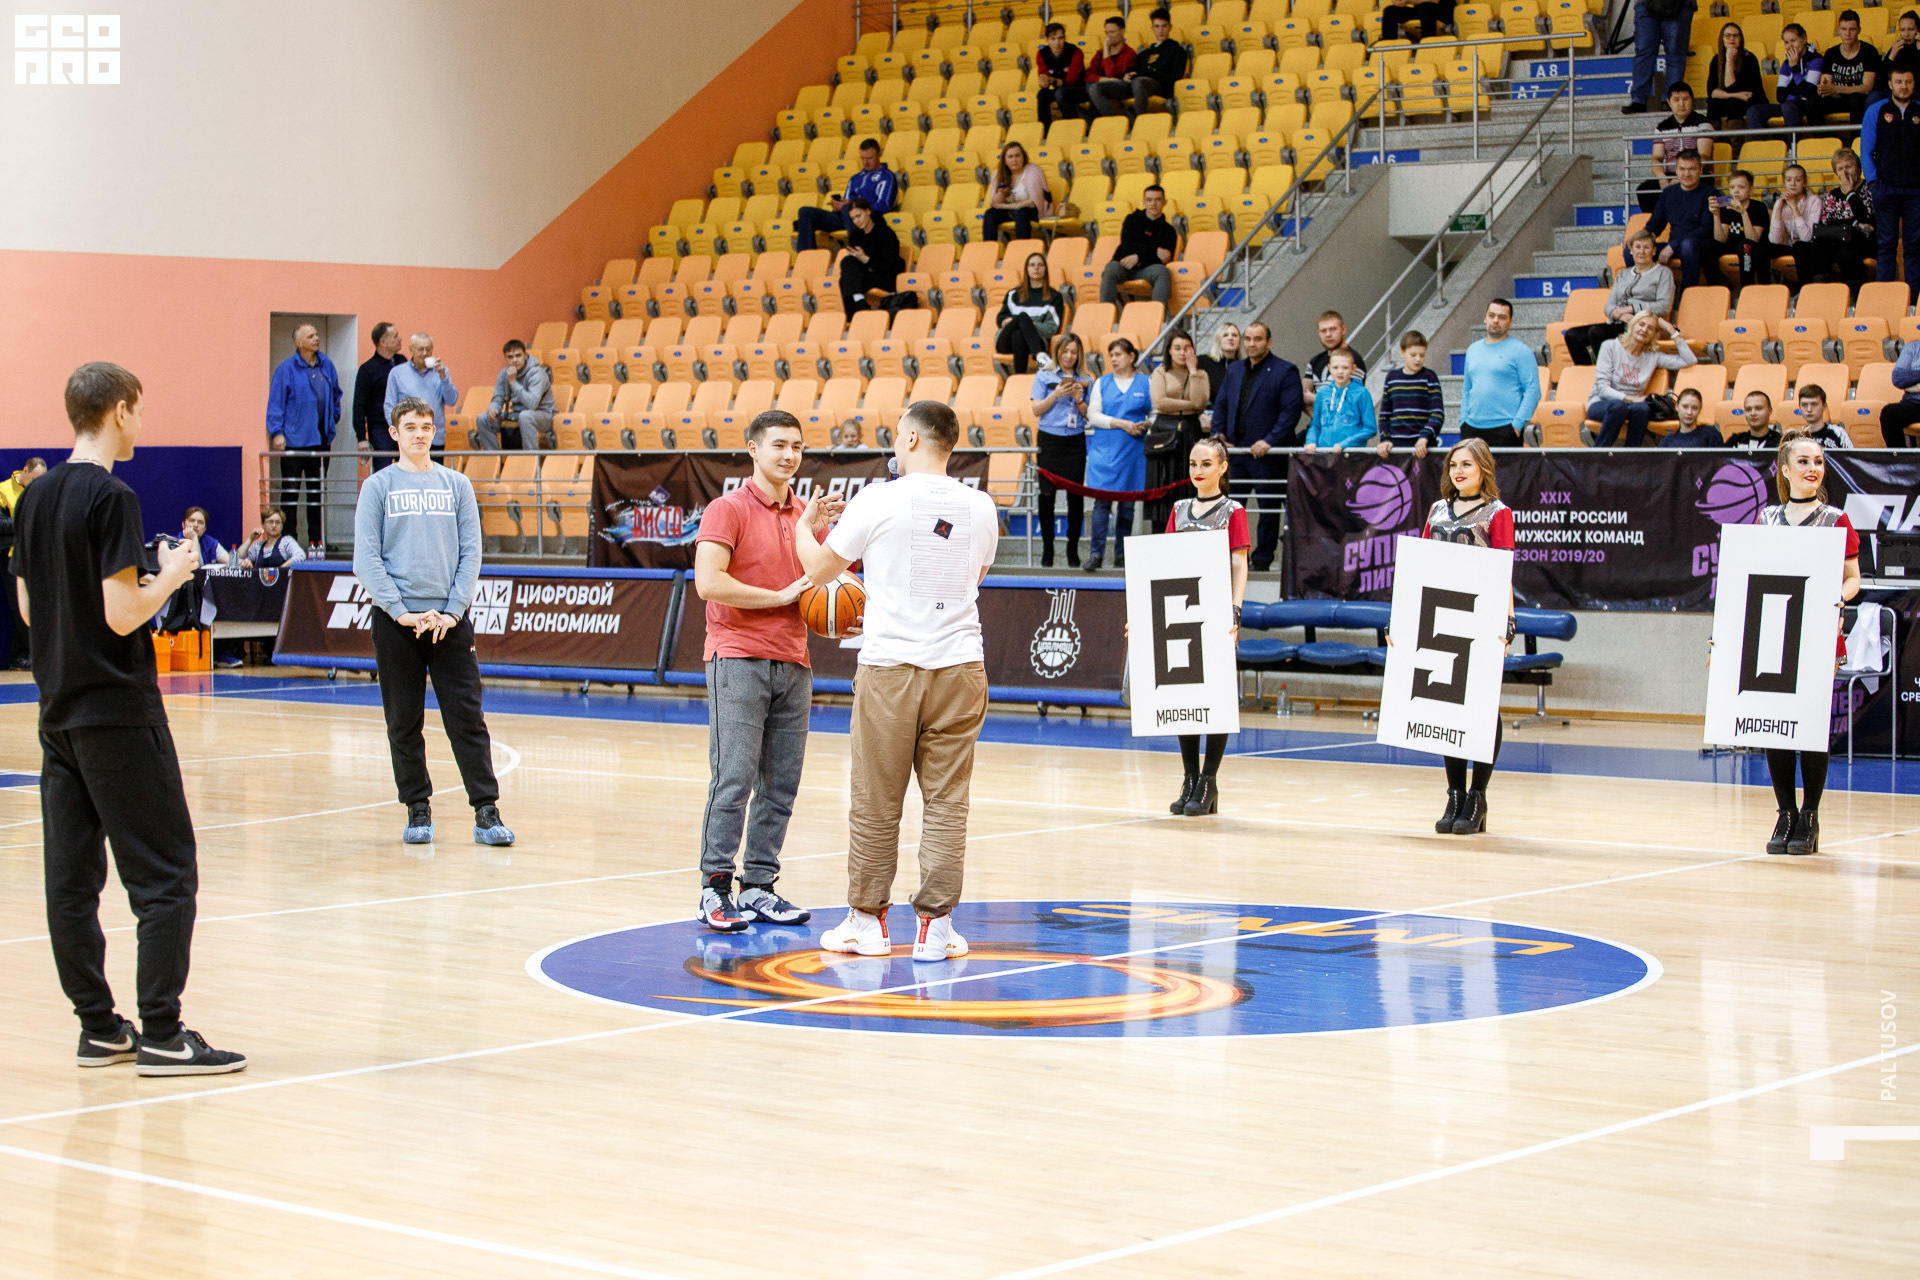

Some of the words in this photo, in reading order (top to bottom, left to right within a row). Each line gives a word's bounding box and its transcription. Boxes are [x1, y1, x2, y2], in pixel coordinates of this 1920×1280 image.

[391, 493, 453, 511] TURNOUT
[1540, 491, 1571, 504] XXIX
[631, 506, 682, 539] ВИСТА
[1511, 511, 1568, 524] ПИОНАТ
[1570, 511, 1628, 524] РОССИИ
[1514, 530, 1582, 543] МУЖСКИХ
[1585, 531, 1645, 545] КОМАНД
[1514, 549, 1548, 562] ЕЗОН
[1551, 549, 1606, 563] 2019/20
[1359, 566, 1395, 594] ЛИГ
[516, 582, 614, 608] ЦИФРОВОЙ
[936, 602, 945, 610] 23
[511, 612, 621, 634] ЭКОНОМИКИ
[1150, 576, 1204, 690] 6
[1410, 586, 1479, 706] 5
[1156, 707, 1210, 728] MADSHOT
[1735, 717, 1799, 740] MADSHOT
[1406, 721, 1466, 749] MADSHOT
